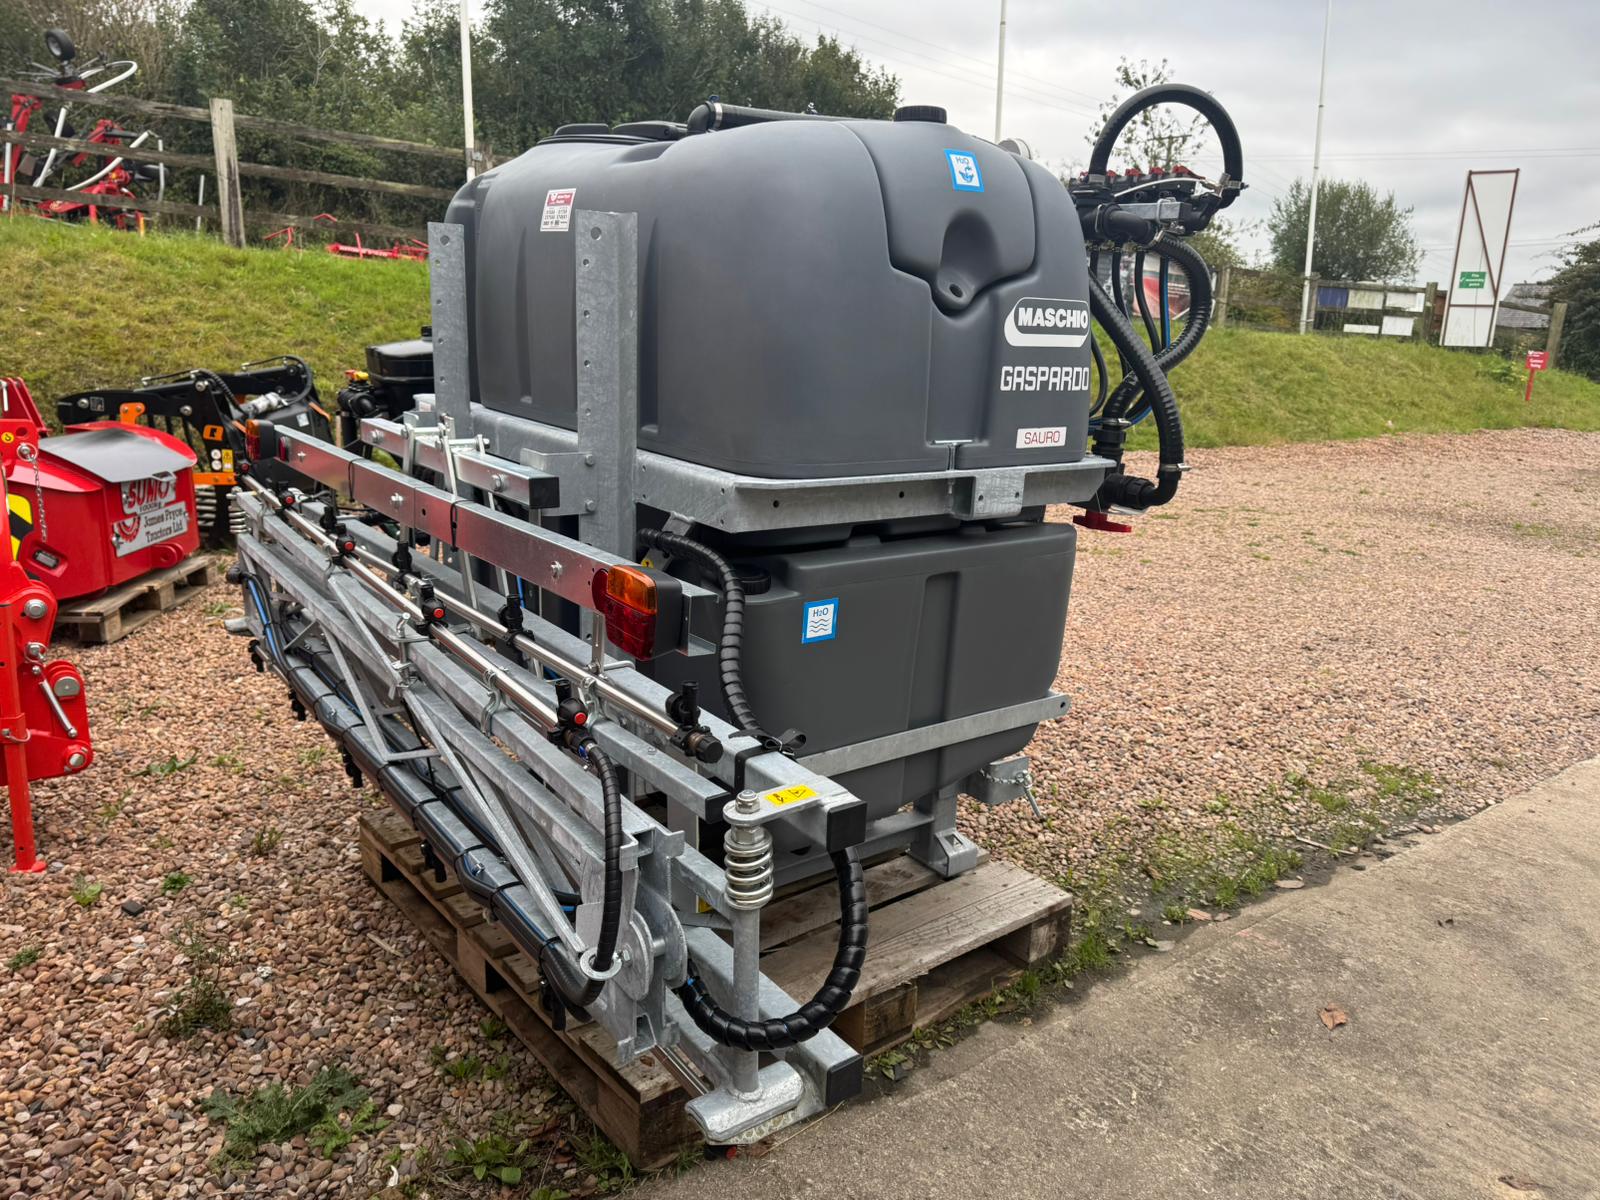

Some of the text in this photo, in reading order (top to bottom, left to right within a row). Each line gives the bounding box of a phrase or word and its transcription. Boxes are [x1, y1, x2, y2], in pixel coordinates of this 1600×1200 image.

[1018, 307, 1088, 329] MASCHIO
[1000, 366, 1089, 391] GASPARDO
[1024, 430, 1061, 445] SAURO
[144, 508, 183, 528] James Pryce
[145, 520, 184, 543] Tractors Ltd
[812, 607, 829, 617] H2O
